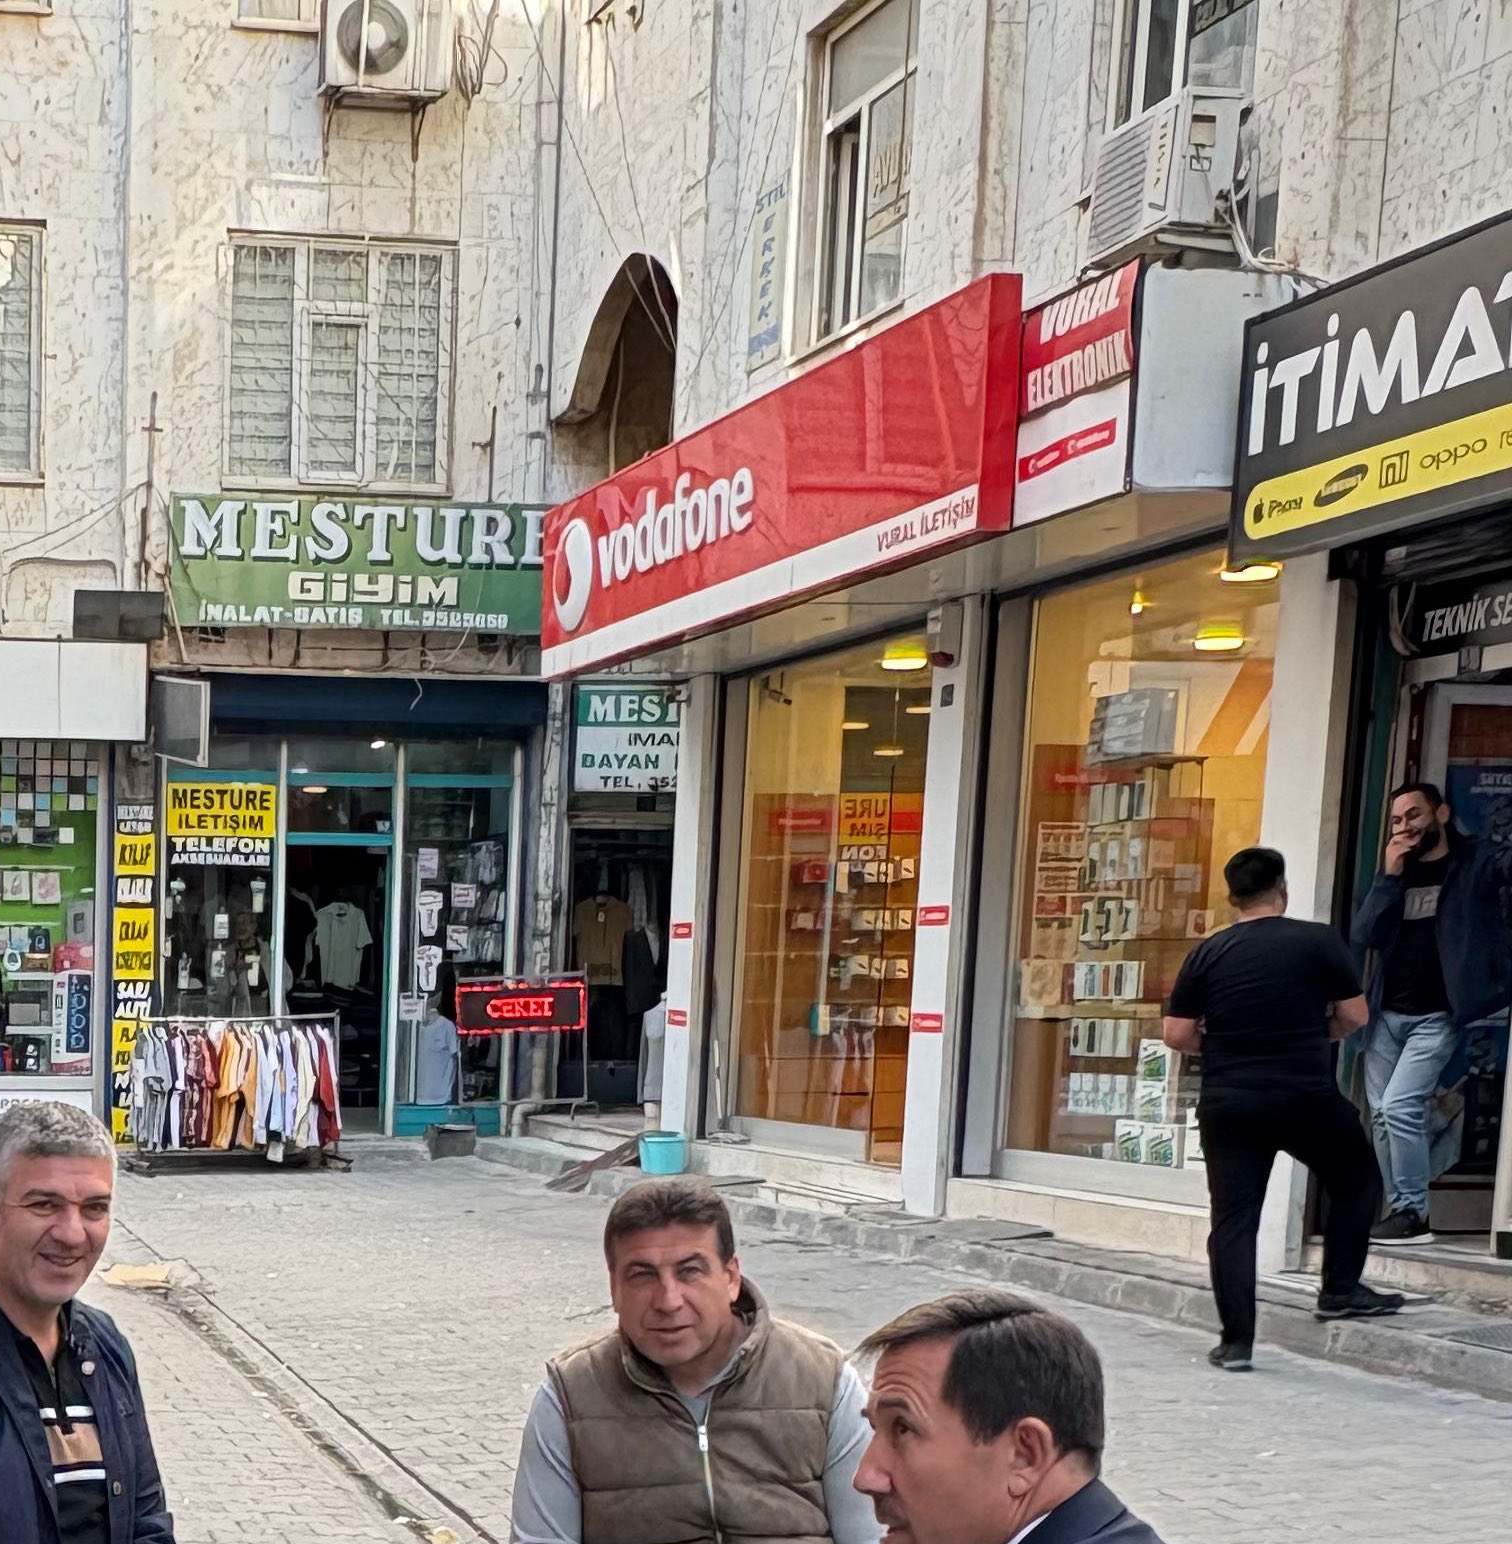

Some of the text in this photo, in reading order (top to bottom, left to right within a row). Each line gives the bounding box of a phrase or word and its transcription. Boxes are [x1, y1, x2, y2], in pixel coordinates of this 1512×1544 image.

[1040, 268, 1123, 345] VURAL
[598, 467, 754, 589] vodafone
[581, 753, 660, 770] BAYAN
[171, 788, 272, 811] MESTURE
[170, 836, 271, 854] TELEFON
